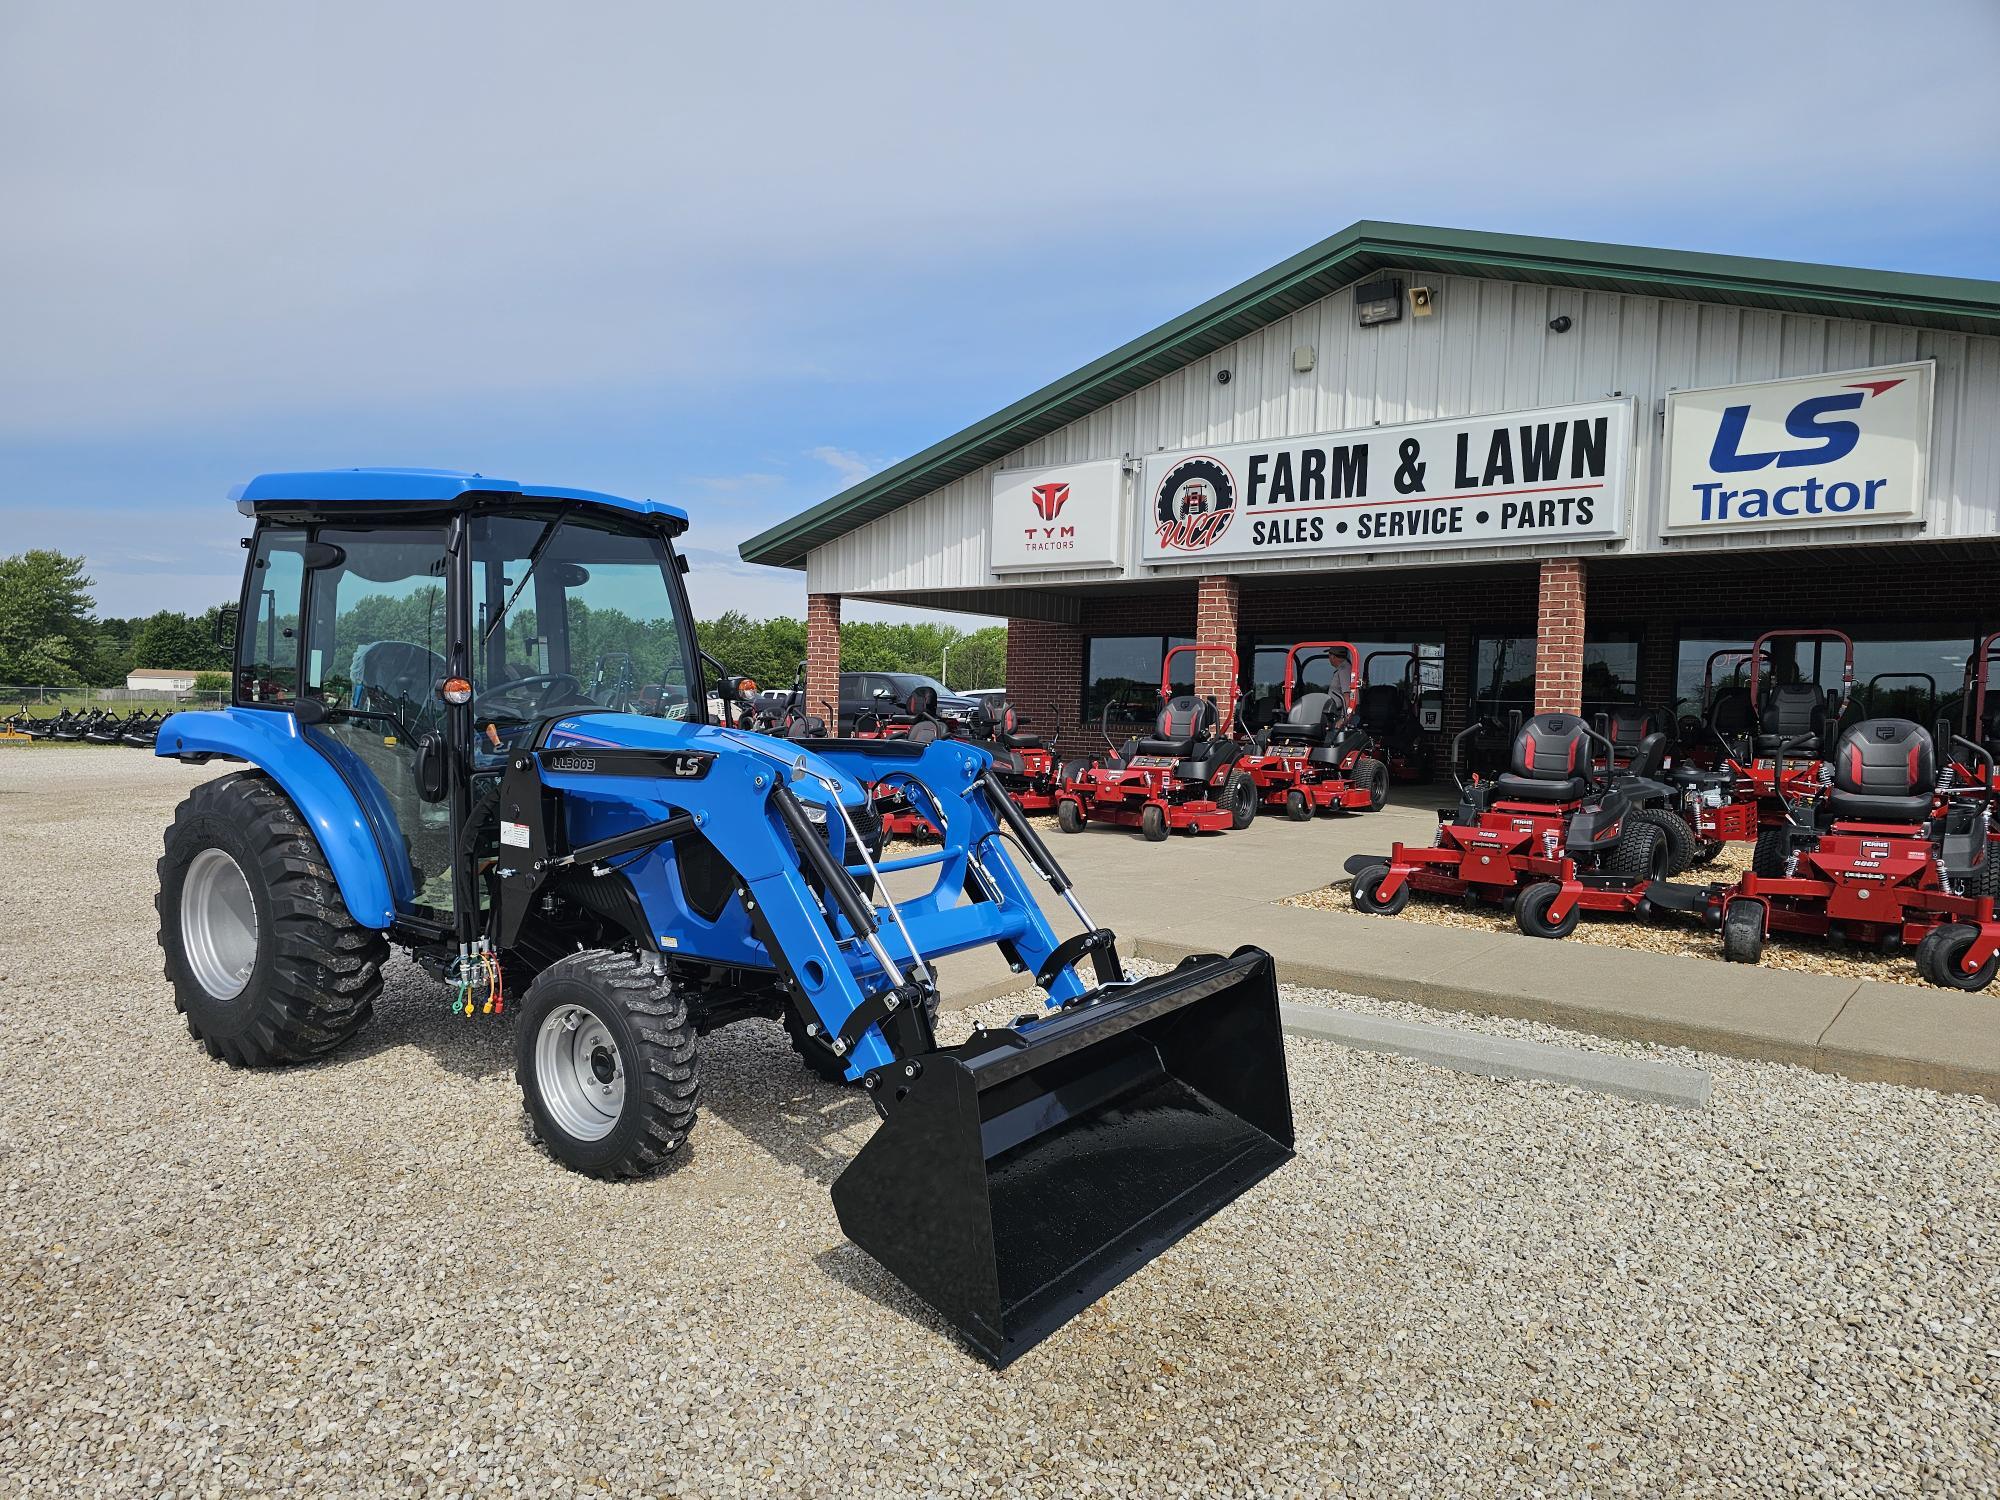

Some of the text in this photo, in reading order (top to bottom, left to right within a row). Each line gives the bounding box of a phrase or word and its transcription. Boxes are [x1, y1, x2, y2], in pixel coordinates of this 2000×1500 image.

[1709, 392, 1865, 473] LS
[1247, 417, 1608, 506] FARM & LAWN
[1692, 477, 1888, 521] Tractor
[1025, 526, 1075, 540] TYM
[1155, 508, 1235, 549] WCT
[1252, 497, 1595, 545] SALES SERVICE PARTS
[1025, 540, 1074, 551] TRACTORS
[552, 757, 596, 771] LL3003
[675, 757, 700, 776] LS
